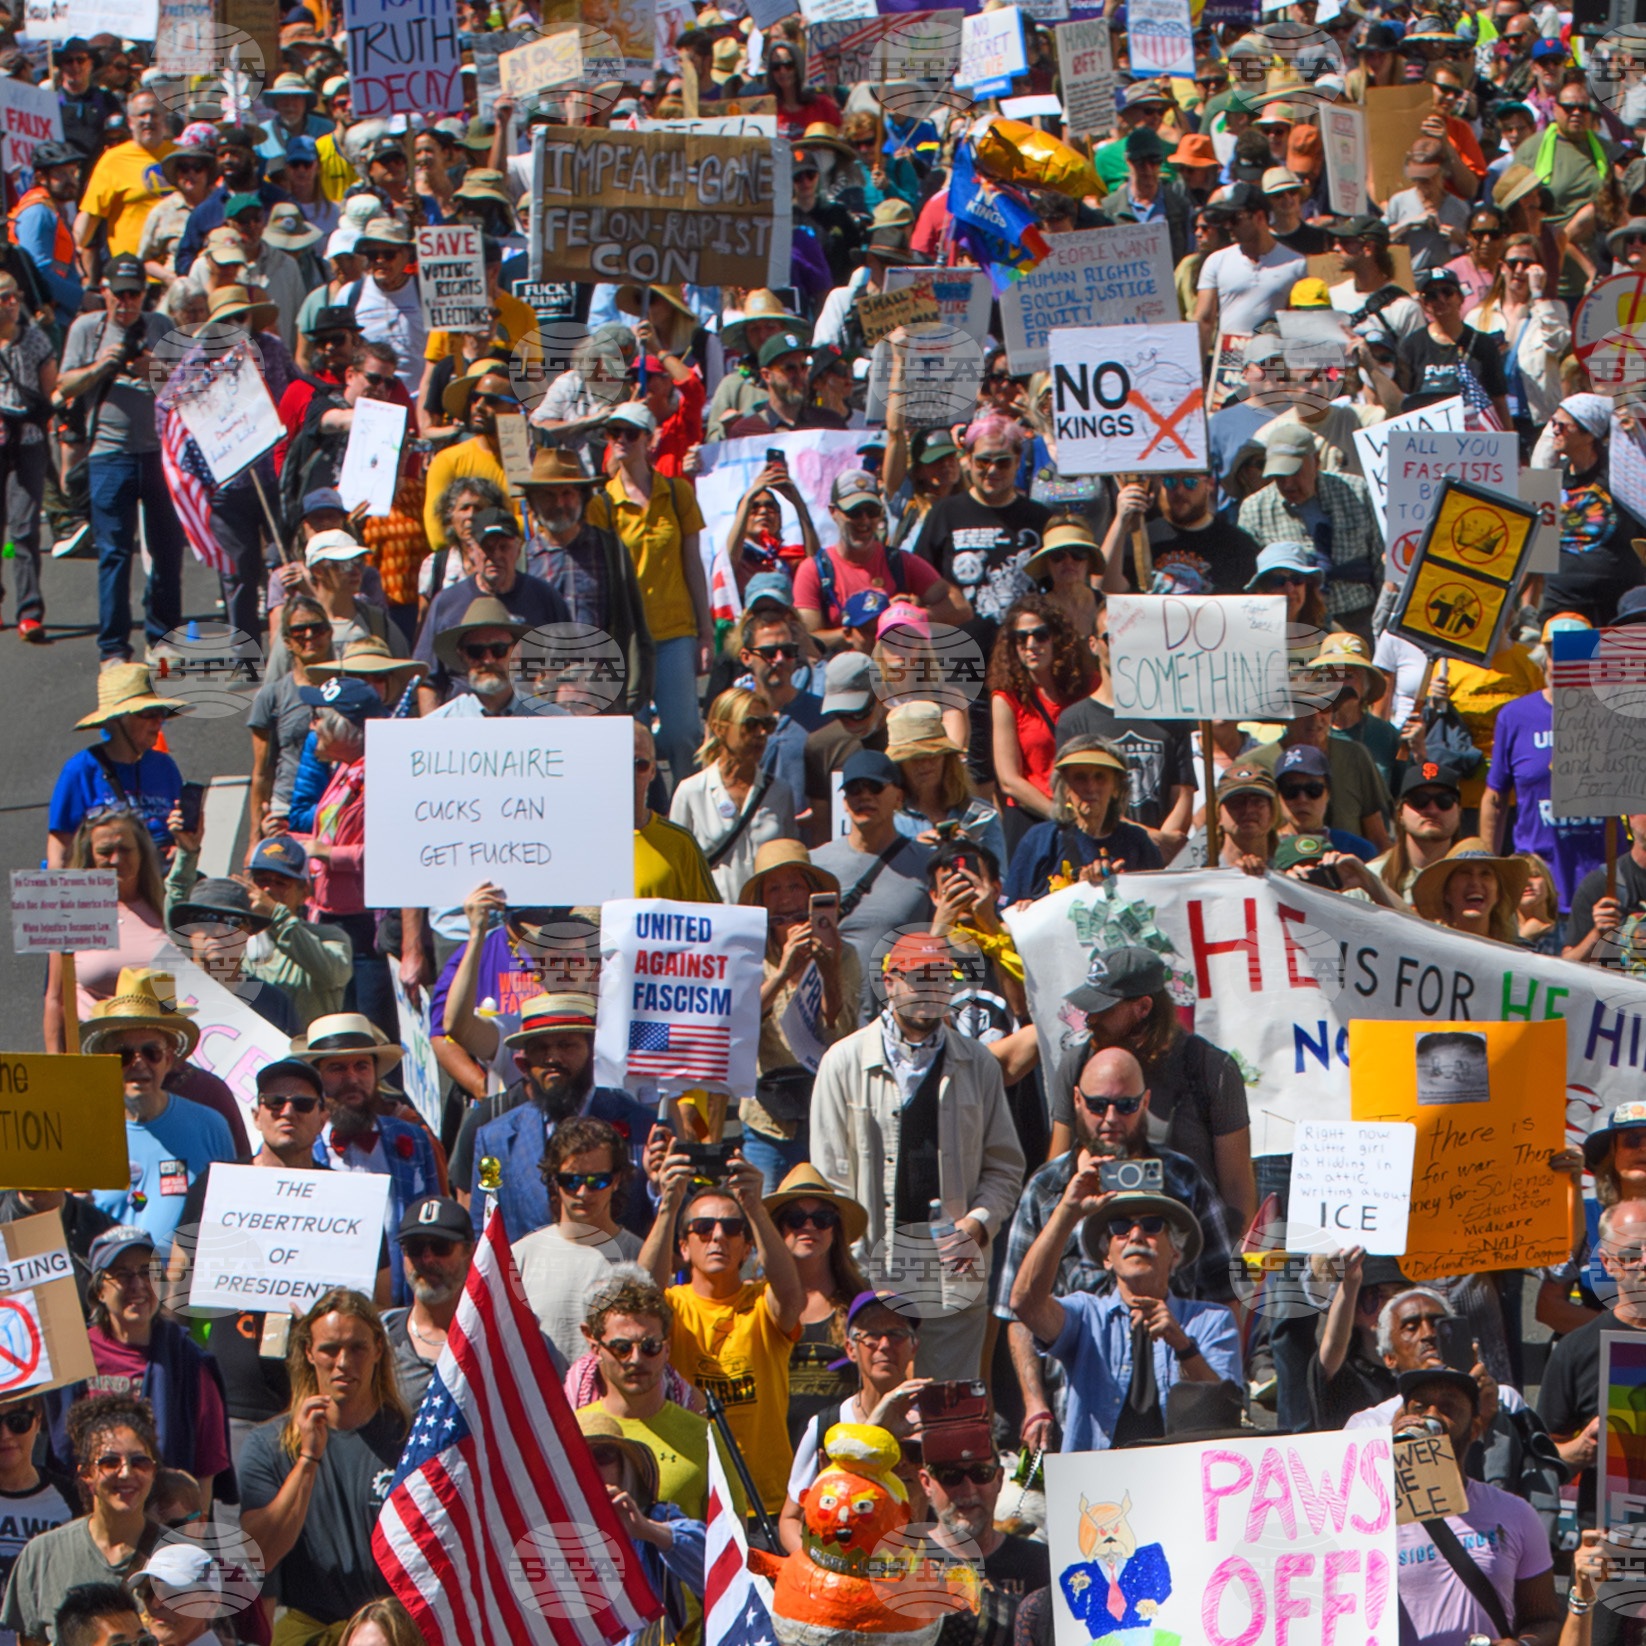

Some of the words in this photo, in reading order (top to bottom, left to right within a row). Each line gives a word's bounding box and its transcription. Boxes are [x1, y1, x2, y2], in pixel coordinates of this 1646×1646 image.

[348, 18, 459, 76] TRUTH
[355, 66, 460, 117] DECAY
[420, 231, 477, 257] SAVE
[591, 243, 699, 284] CON
[1018, 271, 1077, 292] HUMAN
[1084, 261, 1150, 284] RIGHTS
[1020, 290, 1080, 312] SOCIAL
[1023, 306, 1092, 329] EQUITY
[1054, 361, 1131, 411] NO
[1056, 414, 1134, 440] KINGS
[1405, 437, 1438, 454] ALL
[1456, 437, 1499, 457] YOU
[1403, 461, 1504, 483] FASCISTS
[1163, 599, 1226, 651] DO
[1116, 650, 1291, 714] SOMETHING
[410, 749, 565, 778] BILLIONAIRE
[415, 798, 482, 822] CUCKS
[501, 796, 545, 819] CAN
[420, 842, 463, 866] GET
[470, 841, 552, 866] FUCKED
[636, 913, 712, 943] UNITED
[634, 950, 727, 980] AGAINST
[1187, 896, 1321, 999] HE
[1341, 940, 1379, 998] IS
[1395, 957, 1475, 1021] FOR
[633, 981, 732, 1015] FASCISM
[276, 1181, 316, 1198] THE
[221, 1211, 362, 1235] CYBERTRUCK
[268, 1248, 299, 1264] OF
[1199, 1439, 1392, 1544] PAWS
